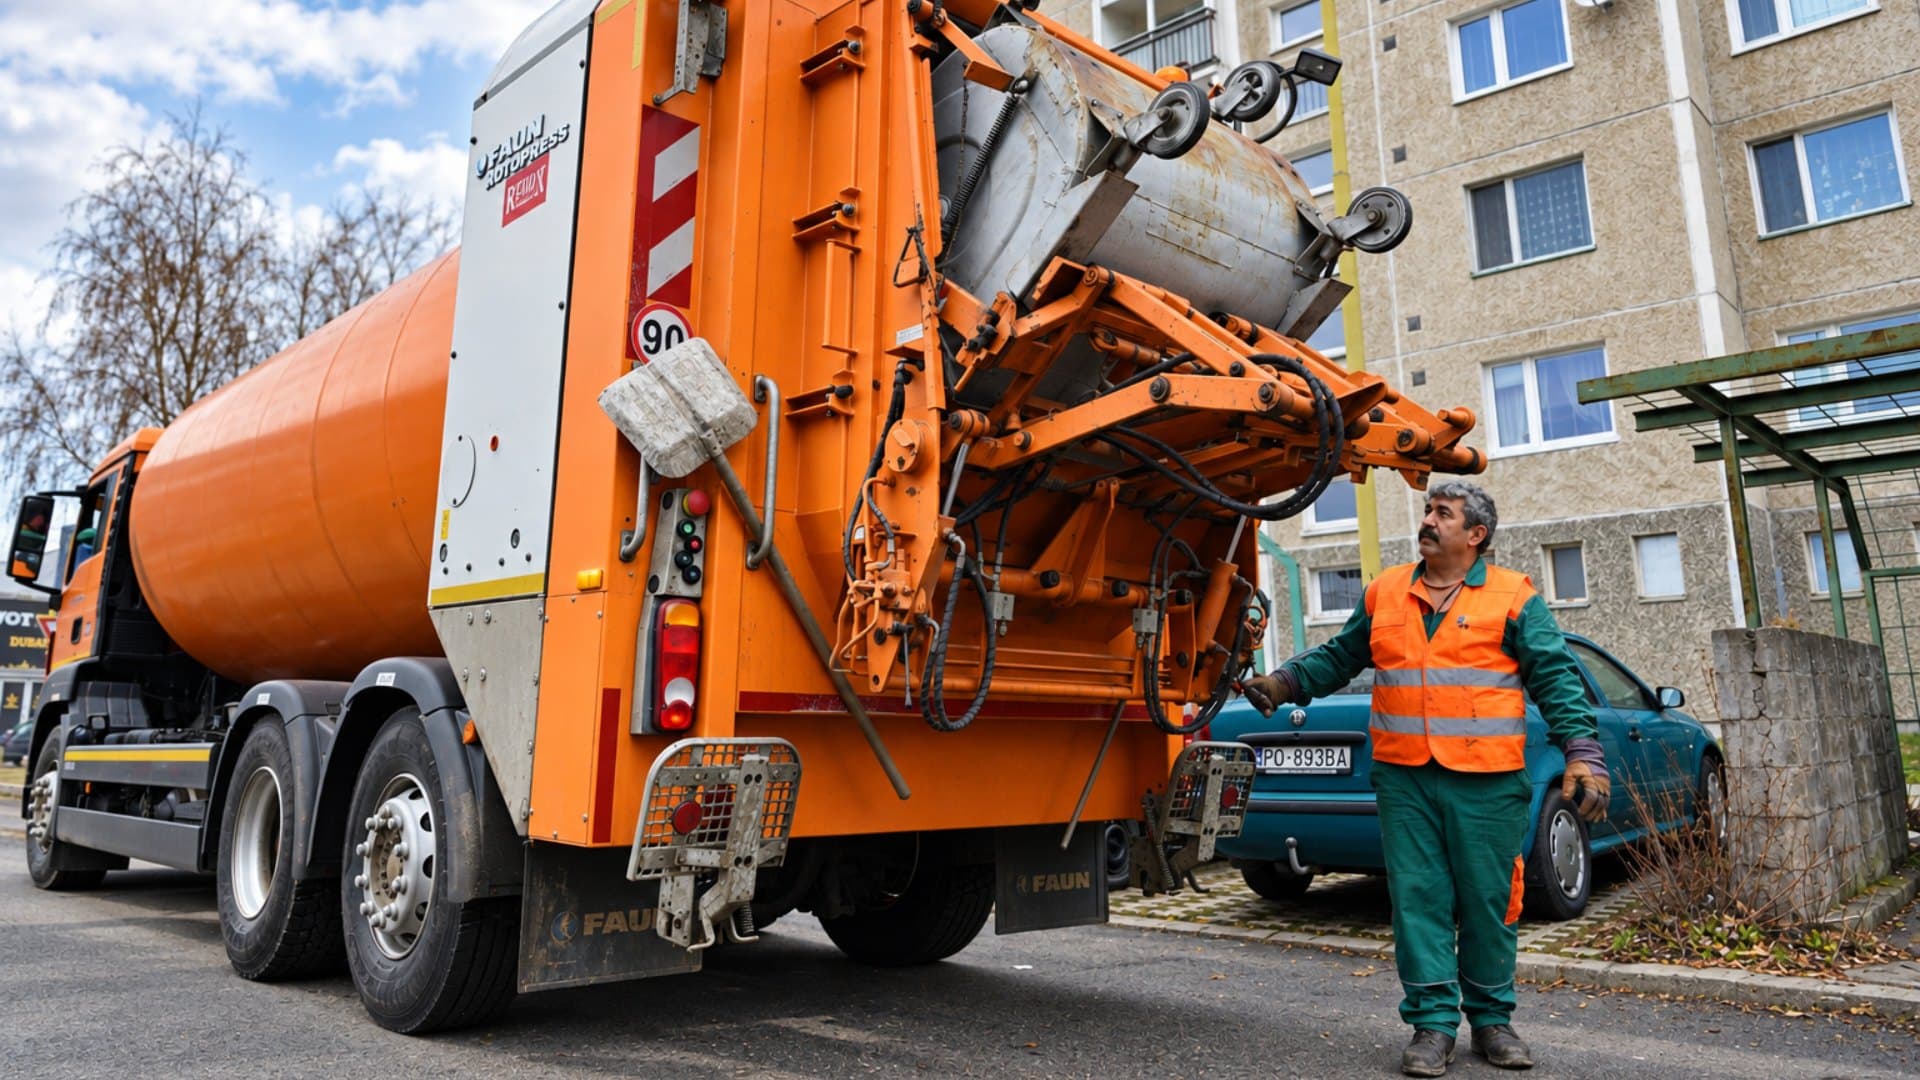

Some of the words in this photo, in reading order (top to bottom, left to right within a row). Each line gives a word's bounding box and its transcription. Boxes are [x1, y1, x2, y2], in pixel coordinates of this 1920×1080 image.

[486, 123, 570, 191] ROTOPRESS
[487, 114, 545, 170] FAUN
[643, 319, 684, 355] 90
[1032, 871, 1090, 893] FAUN
[583, 907, 658, 936] FAU
